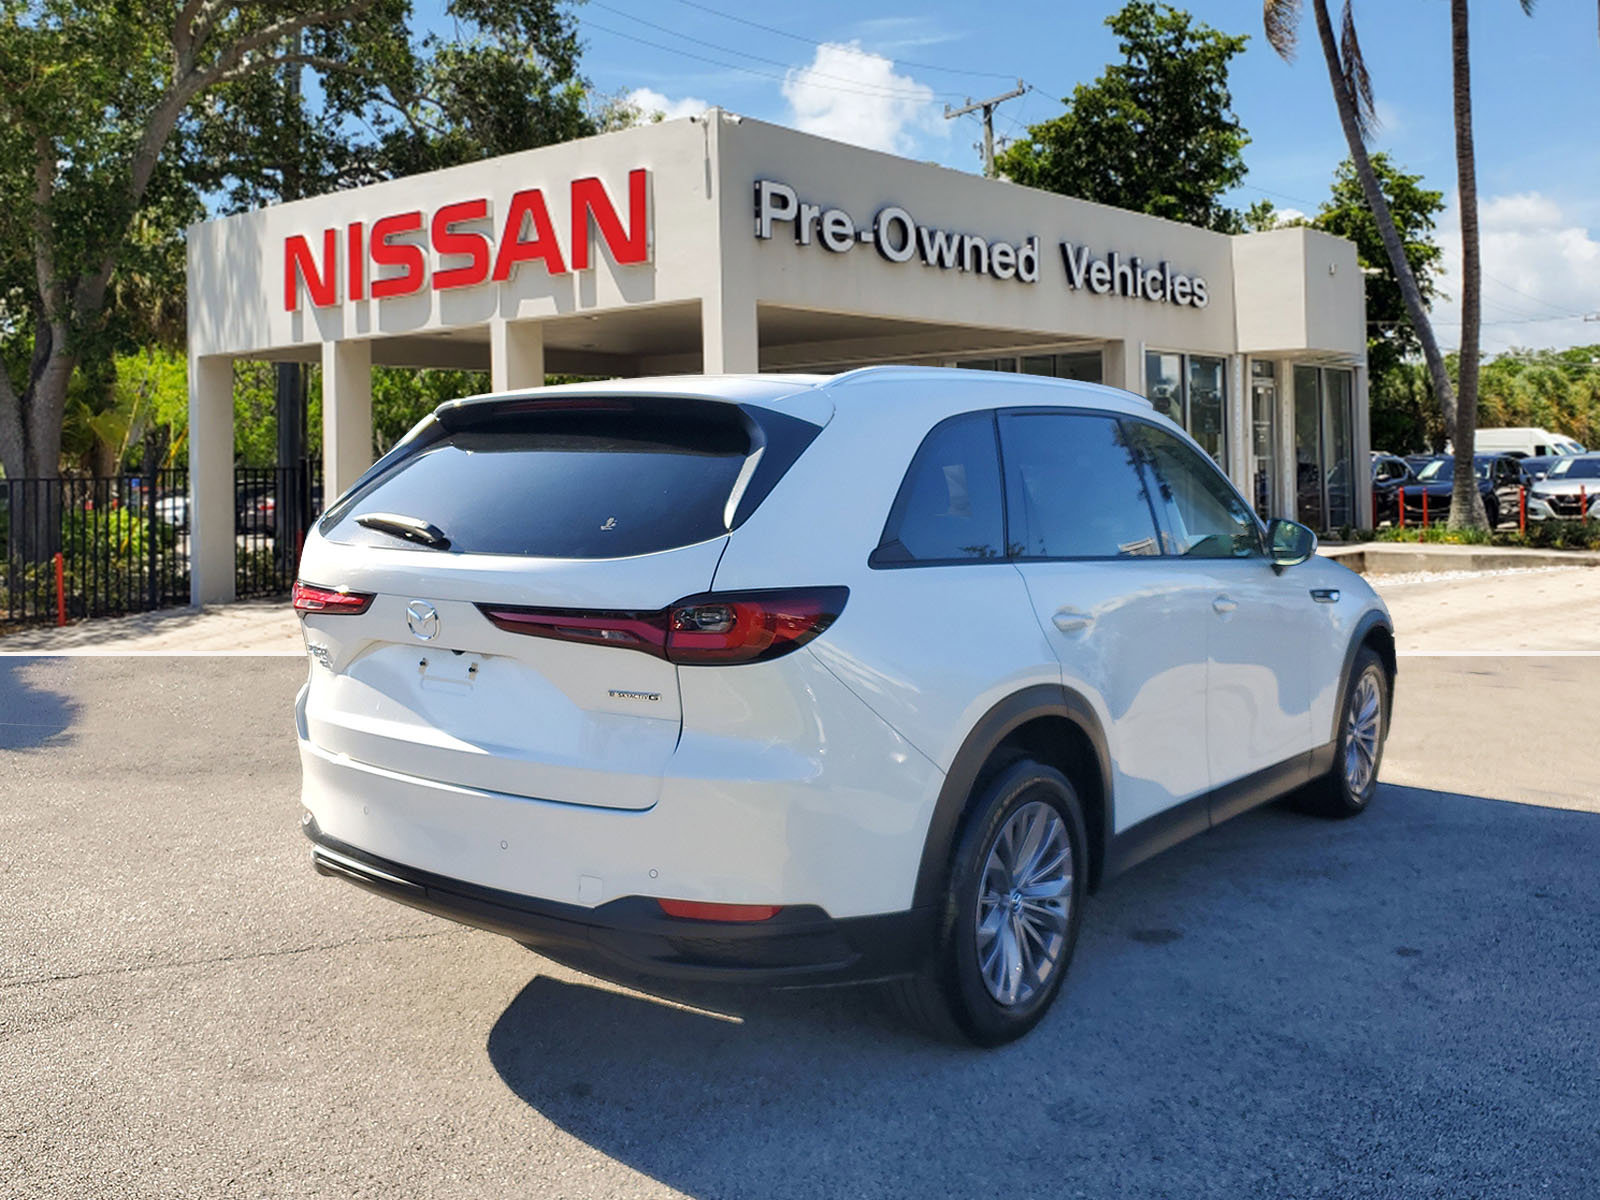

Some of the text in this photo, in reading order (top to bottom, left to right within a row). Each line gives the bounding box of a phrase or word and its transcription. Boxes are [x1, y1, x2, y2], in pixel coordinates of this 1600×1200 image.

[285, 168, 647, 312] NISSAN
[754, 179, 1209, 309] Pre-Owned Vehicles
